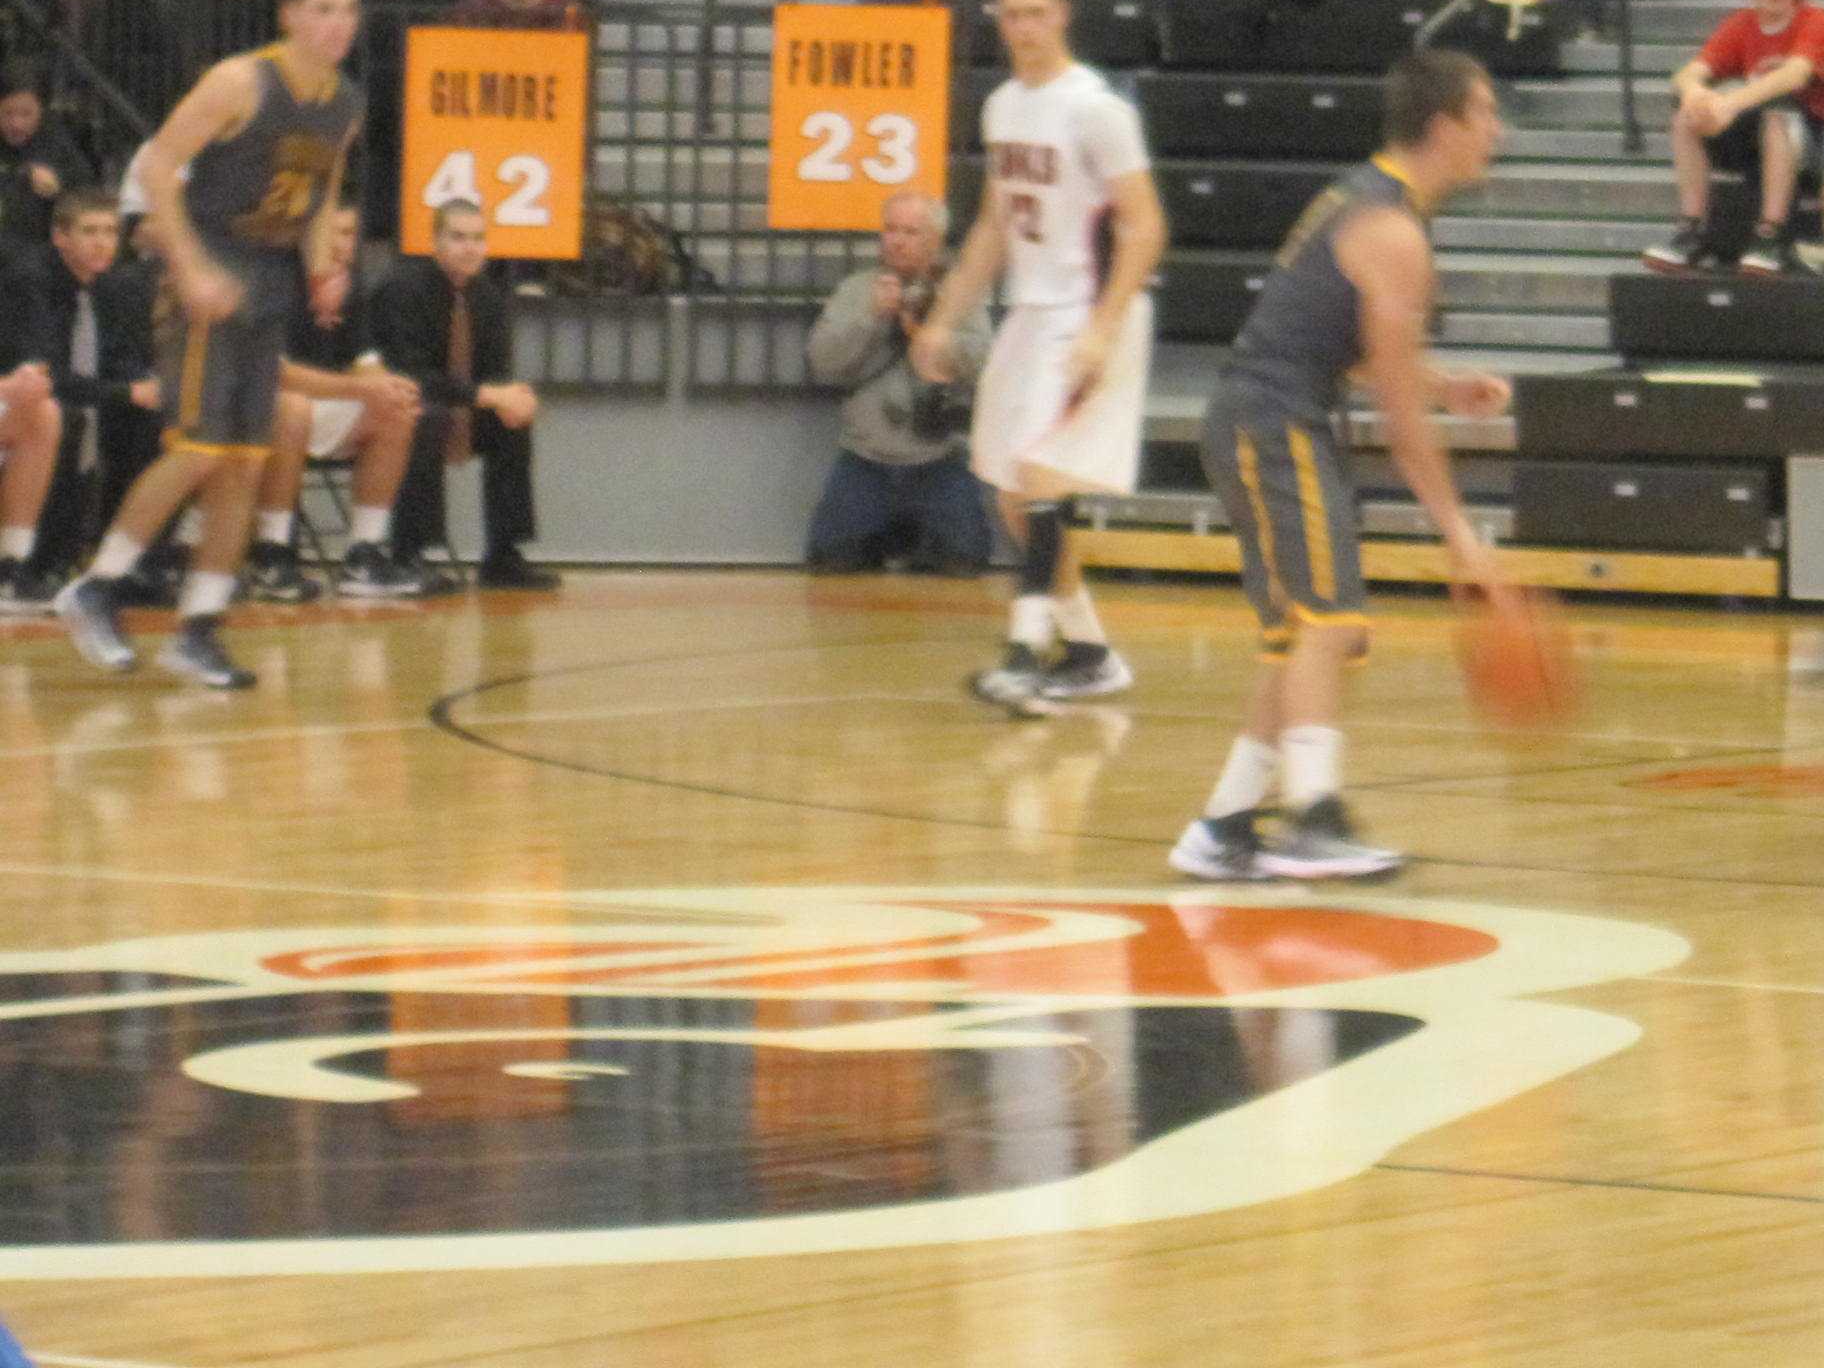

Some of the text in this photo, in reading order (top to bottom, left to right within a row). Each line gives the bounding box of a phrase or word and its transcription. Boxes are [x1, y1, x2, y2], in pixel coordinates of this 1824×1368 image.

[429, 68, 559, 122] GILMORE
[787, 39, 917, 90] FOWLER
[797, 110, 919, 184] 23
[423, 150, 552, 227] 42
